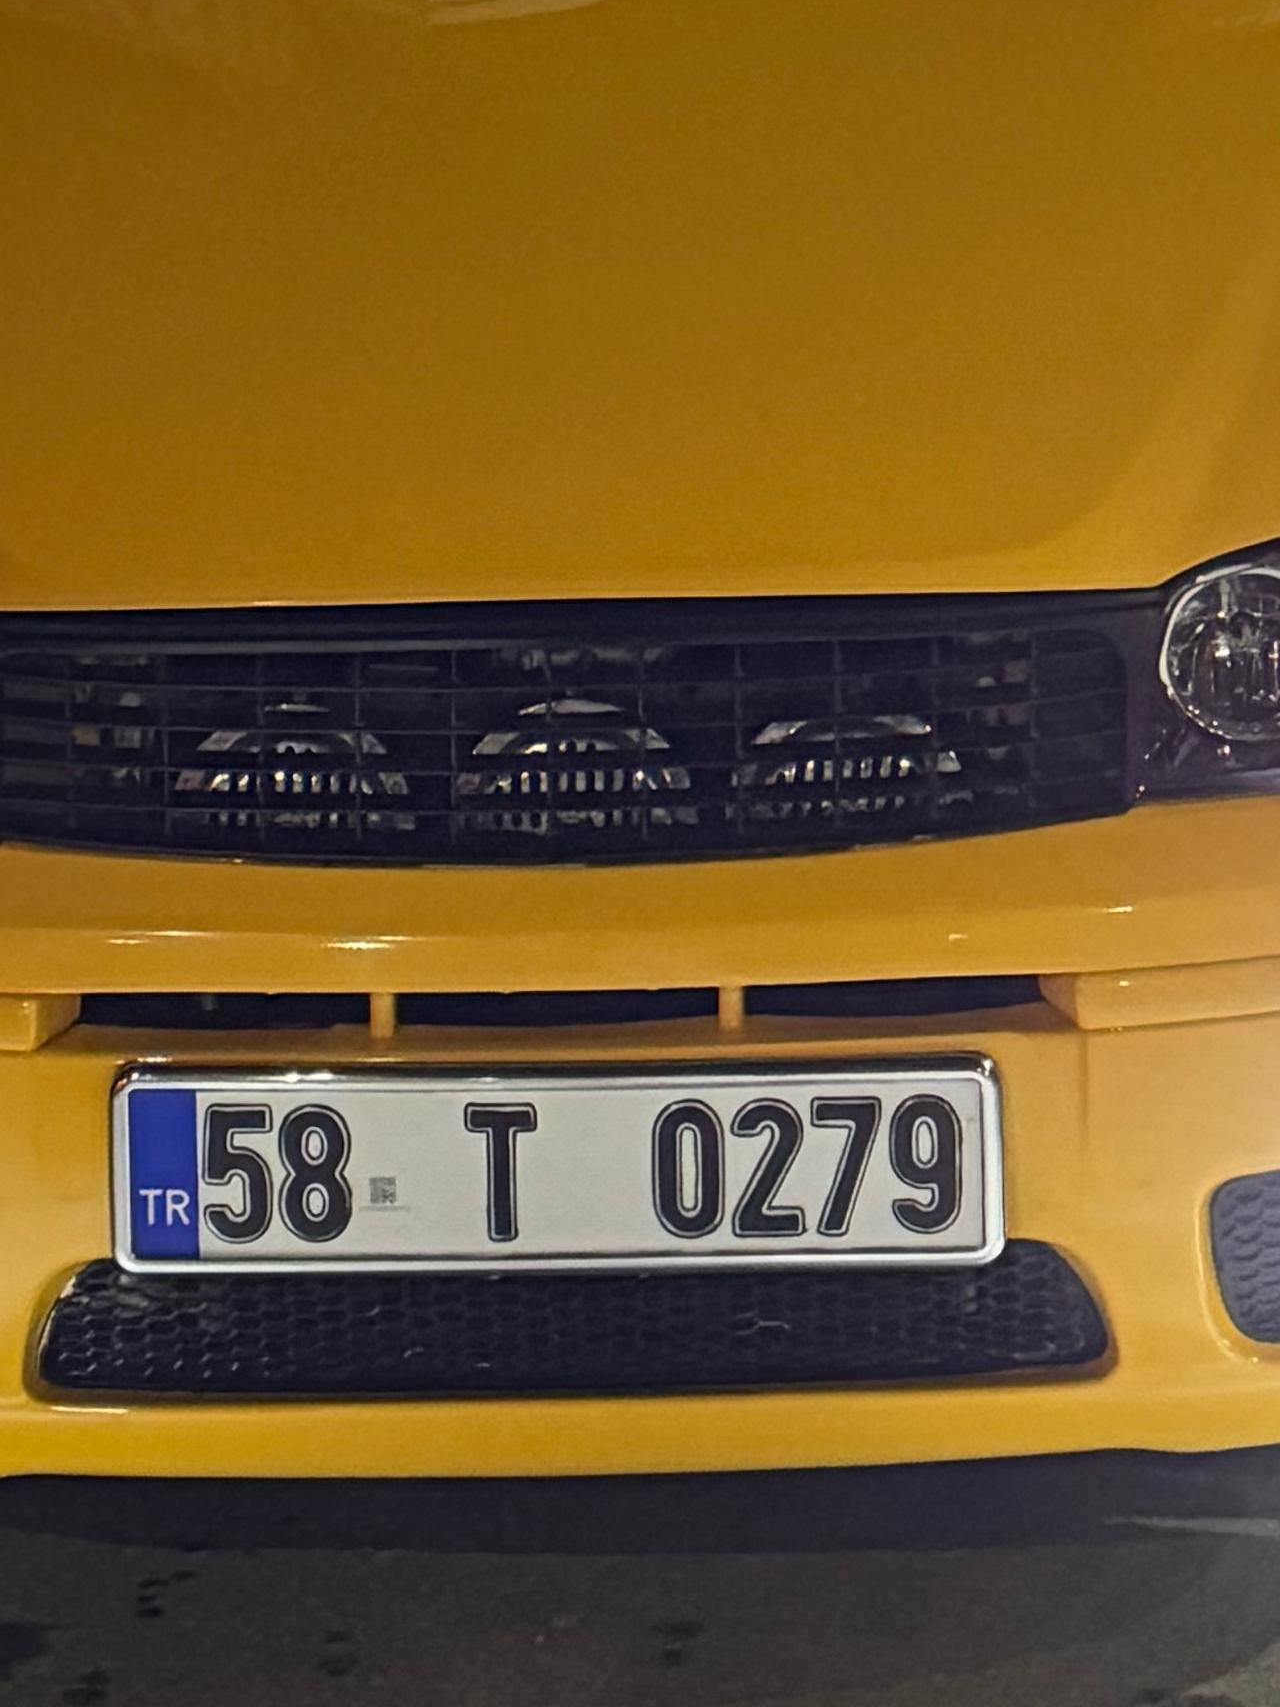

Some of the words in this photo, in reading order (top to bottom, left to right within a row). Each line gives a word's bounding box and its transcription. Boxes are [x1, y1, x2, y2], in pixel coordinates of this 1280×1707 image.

[139, 1189, 190, 1226] TR
[202, 1103, 353, 1244] 58
[465, 1102, 537, 1243] T
[652, 1093, 963, 1239] 0279
